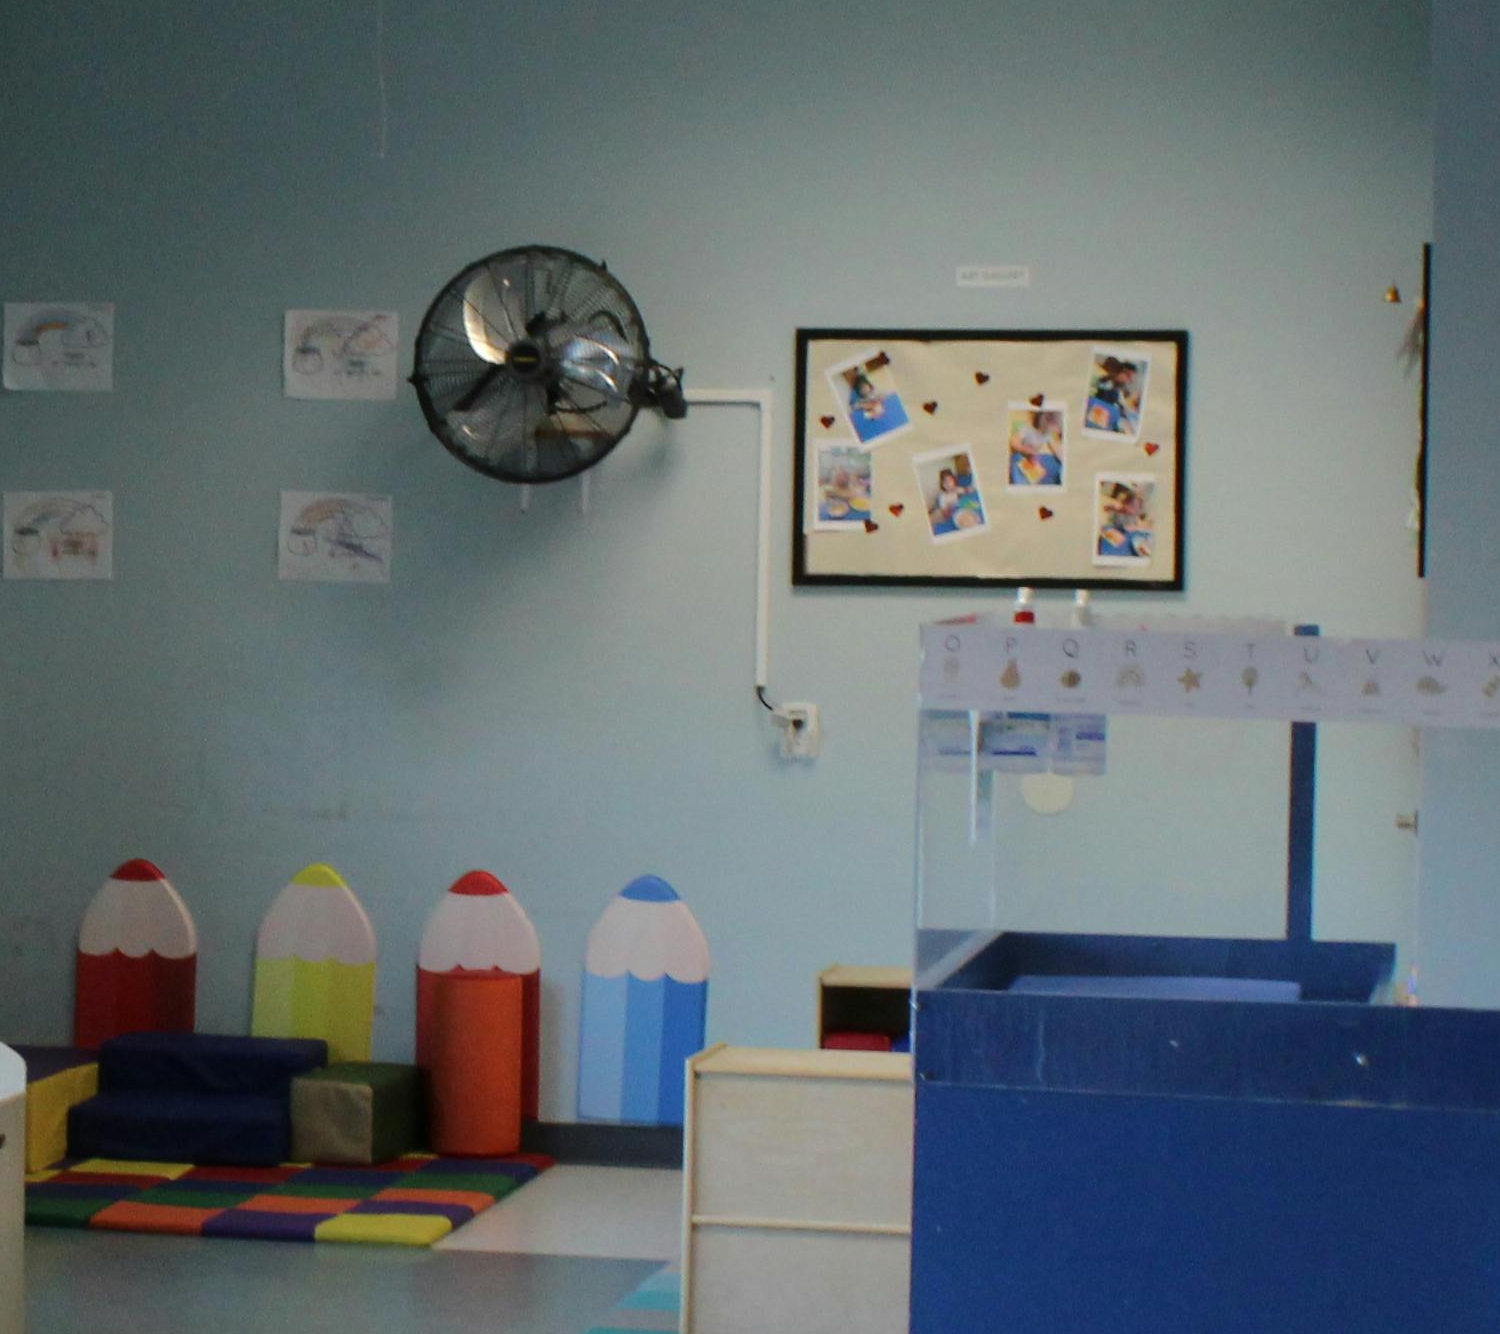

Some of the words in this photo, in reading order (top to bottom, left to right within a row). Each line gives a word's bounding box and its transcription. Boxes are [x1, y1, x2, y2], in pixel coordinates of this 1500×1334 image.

[944, 634, 961, 653] O
[1005, 636, 1018, 654] P
[1062, 638, 1080, 659] Q
[1124, 639, 1137, 656] R
[1184, 641, 1197, 659] S
[1244, 643, 1257, 659] T
[1303, 645, 1320, 665] U
[1365, 648, 1380, 665] V
[1422, 649, 1444, 667] W
[1488, 651, 1500, 667] X
